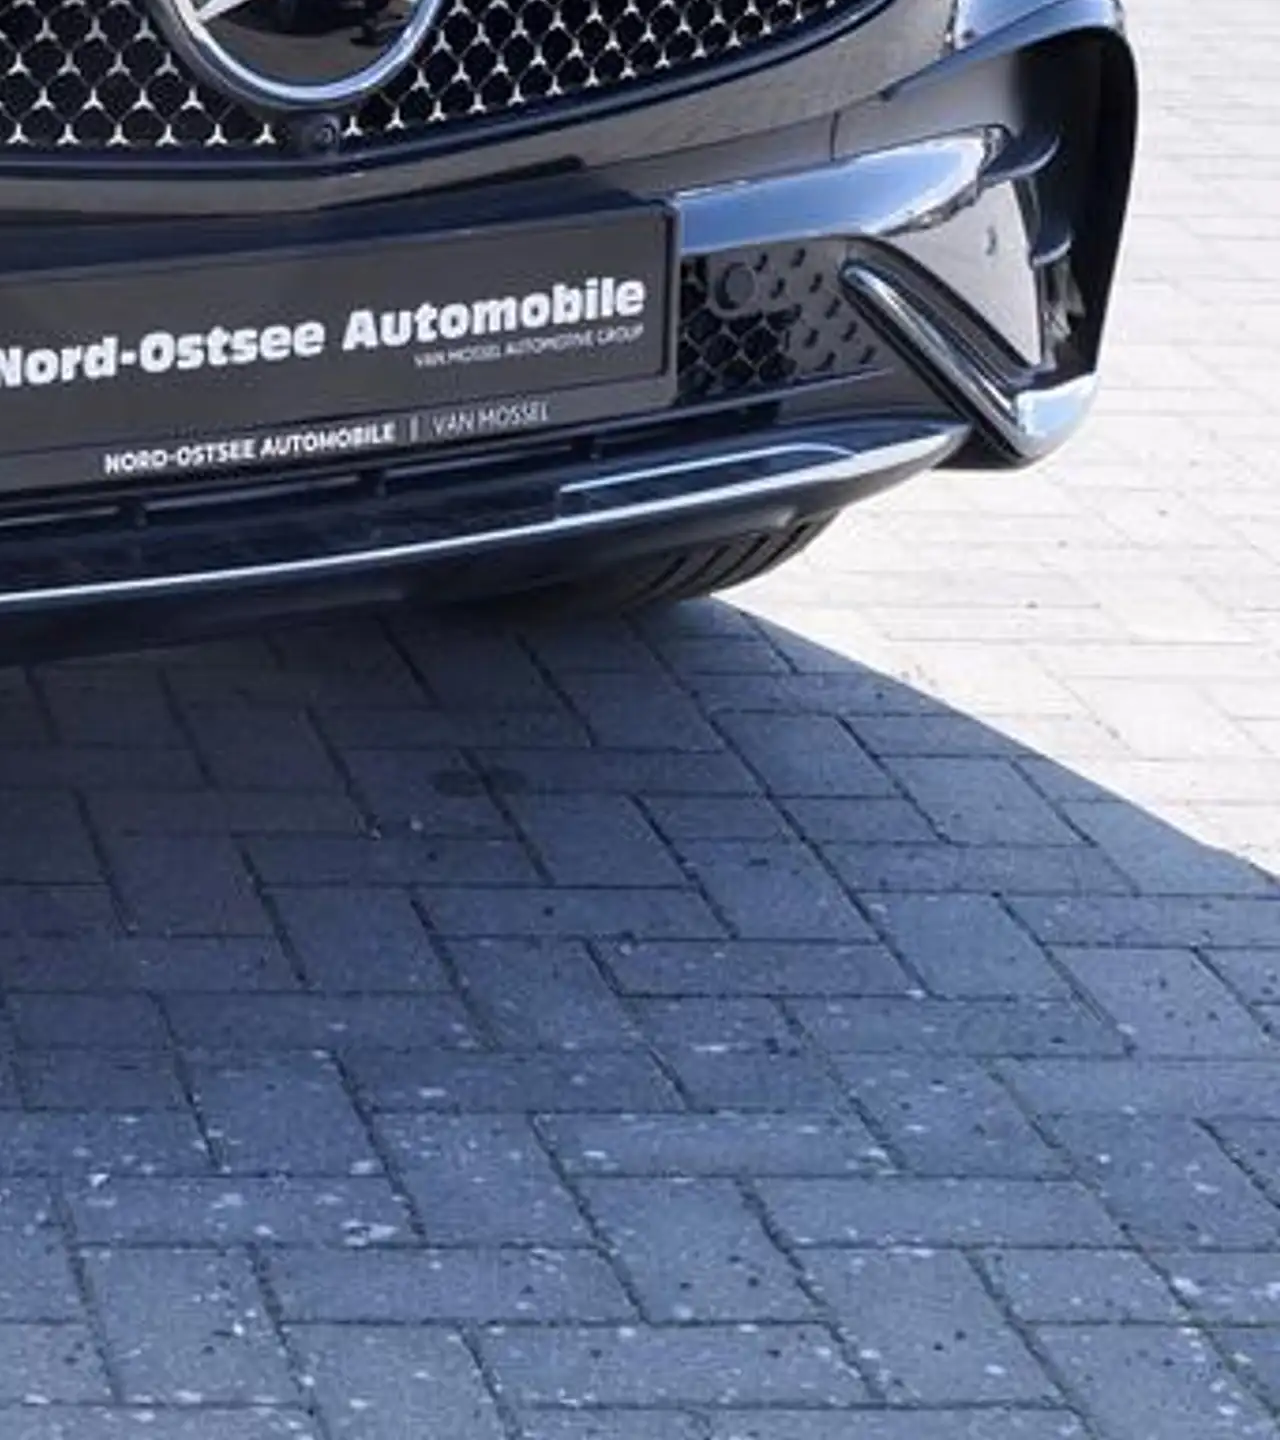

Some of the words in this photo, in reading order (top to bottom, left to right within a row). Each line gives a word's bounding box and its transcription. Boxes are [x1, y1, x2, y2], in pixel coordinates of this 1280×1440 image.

[342, 278, 645, 351] Automobile
[414, 349, 446, 368] VAN
[449, 344, 502, 364] MOSSEL
[505, 332, 593, 356] AUTOMOTIVE
[597, 323, 644, 345] GROUP
[104, 435, 255, 474] NORD-OSTSEE
[259, 422, 396, 458] AUTOMOBILE
[432, 411, 474, 437] VAN
[480, 402, 549, 431] MOSSEL
